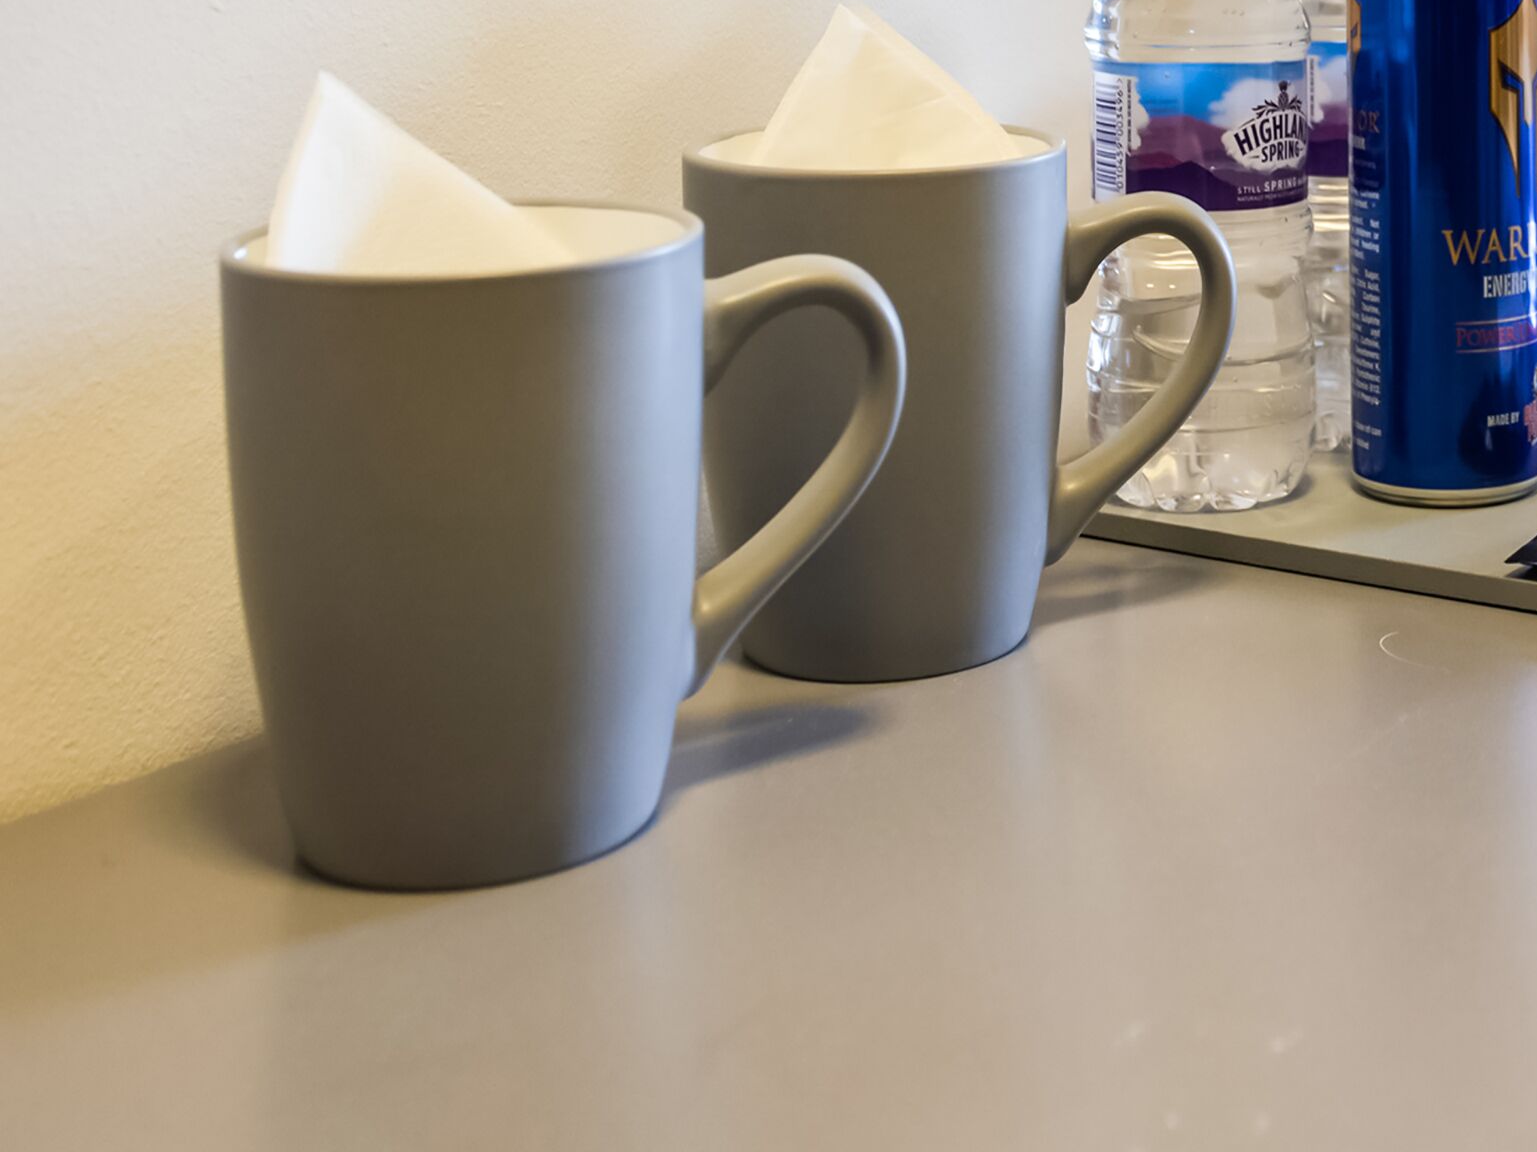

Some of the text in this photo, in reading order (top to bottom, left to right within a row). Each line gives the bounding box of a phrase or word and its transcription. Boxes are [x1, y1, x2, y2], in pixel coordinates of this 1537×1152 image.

[1261, 139, 1299, 163] SPRING
[1237, 185, 1261, 195] STILL
[1264, 177, 1296, 193] SPRING
[1487, 411, 1519, 427] MADE BY
